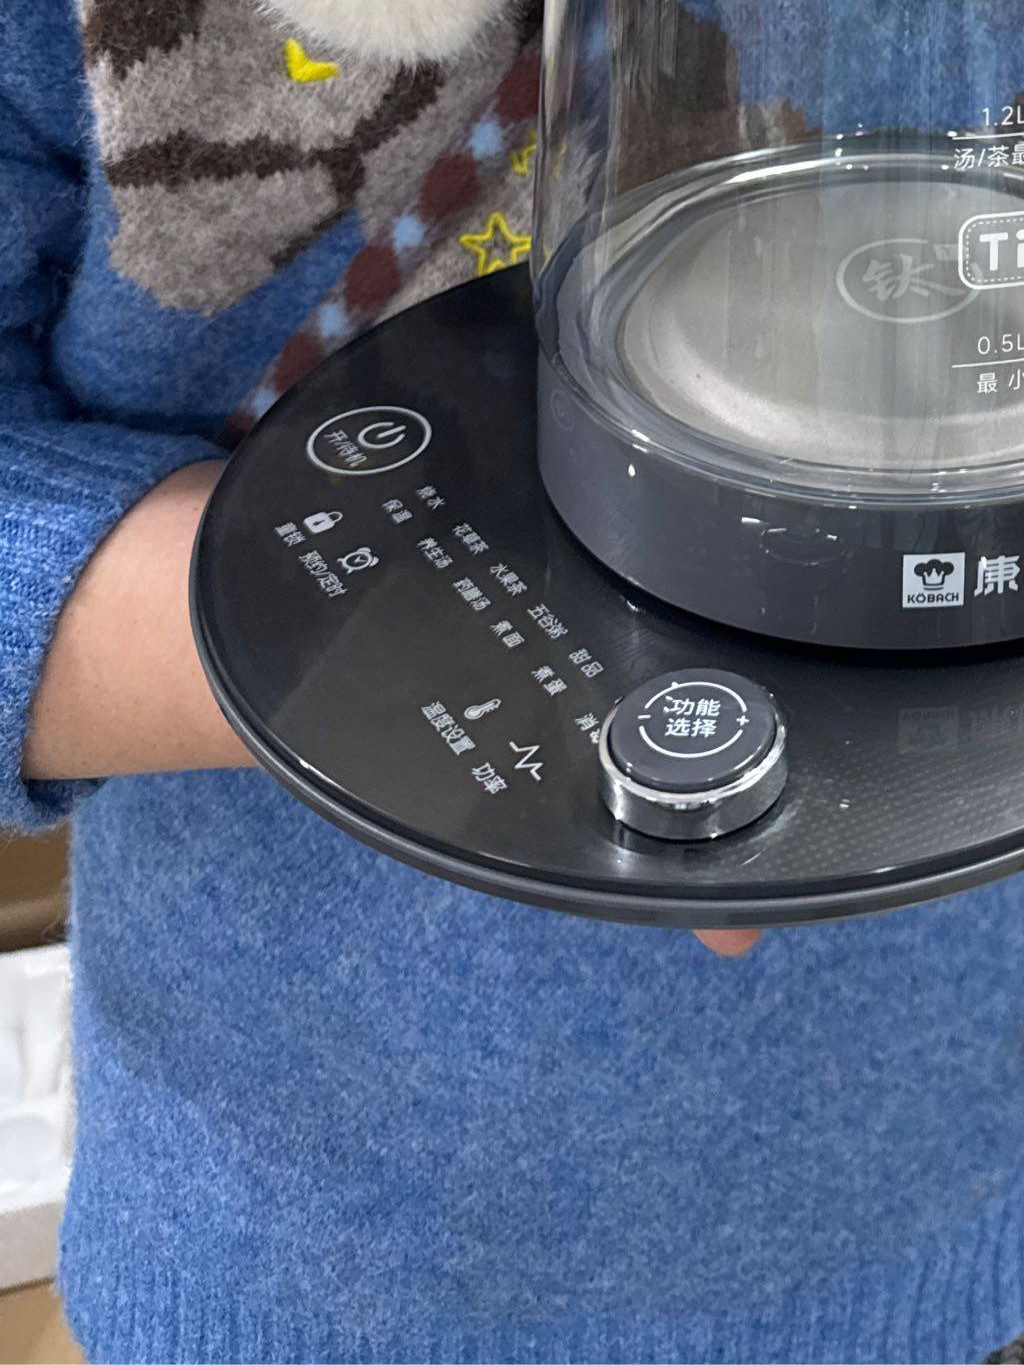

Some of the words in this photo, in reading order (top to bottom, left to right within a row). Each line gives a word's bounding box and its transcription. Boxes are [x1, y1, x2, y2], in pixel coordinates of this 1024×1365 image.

[382, 499, 413, 523] 保温
[416, 485, 446, 510] 烧水
[416, 537, 453, 568] 养生汤
[452, 523, 489, 555] 花草茶
[299, 550, 348, 597] 预约/定时
[489, 562, 528, 596] 水果茶
[452, 577, 491, 611] 药膳汤
[491, 620, 525, 648] 煮面
[527, 603, 568, 639] 五谷粥
[569, 648, 604, 678] 甜品
[531, 665, 567, 696] 煮蛋
[668, 698, 721, 716] 功能
[421, 700, 476, 756] 温度设置
[664, 718, 717, 737] 选择
[471, 762, 508, 794] 功率
